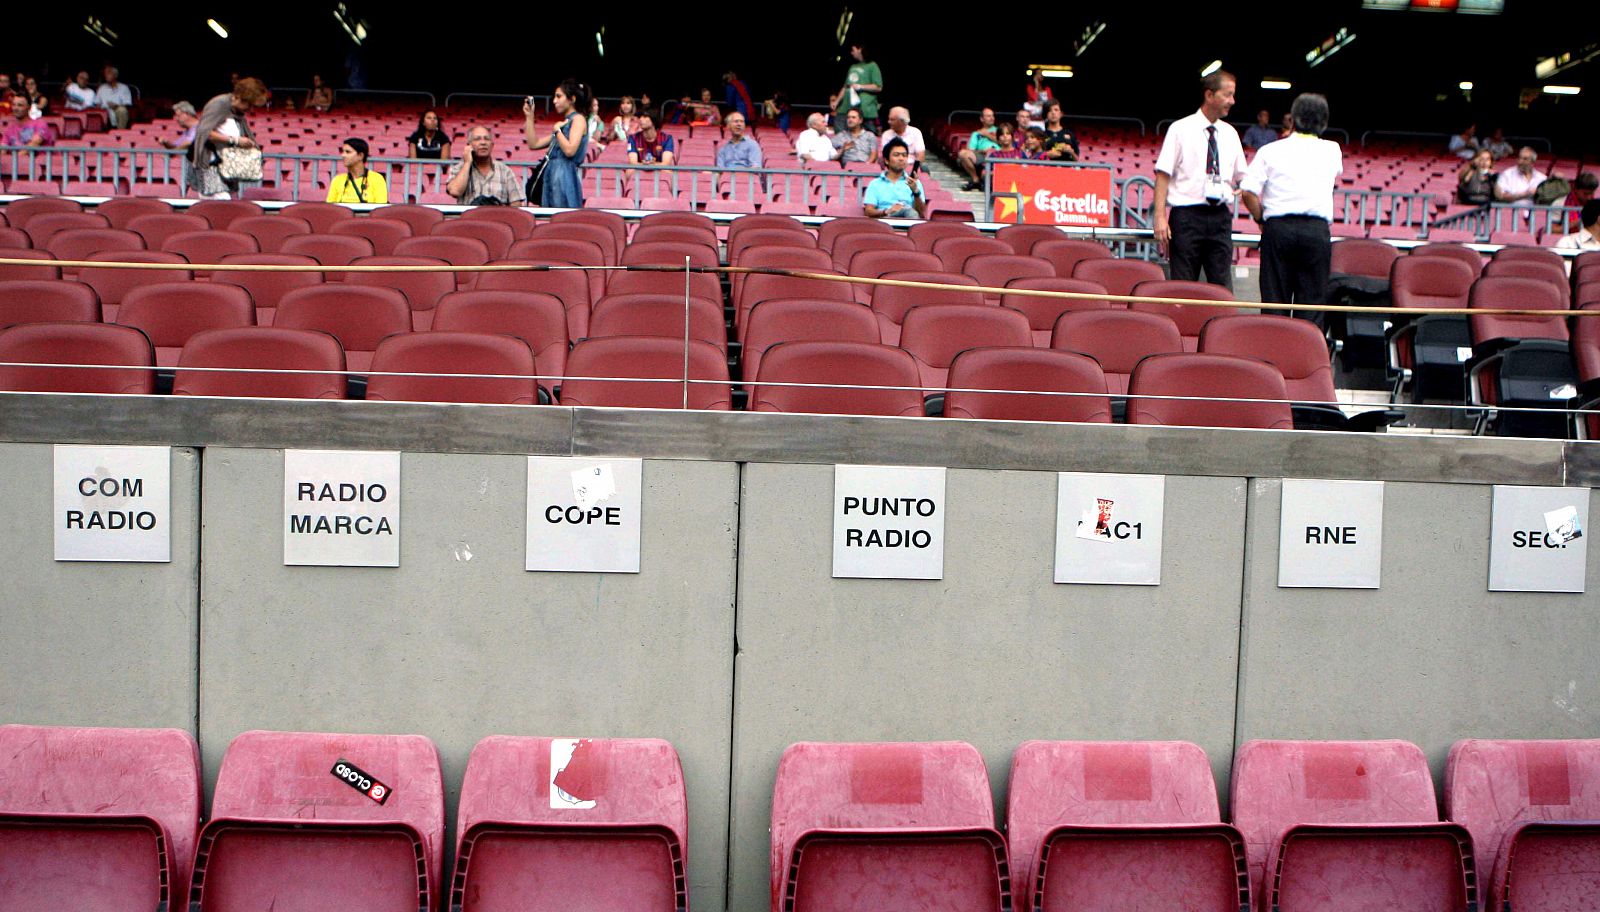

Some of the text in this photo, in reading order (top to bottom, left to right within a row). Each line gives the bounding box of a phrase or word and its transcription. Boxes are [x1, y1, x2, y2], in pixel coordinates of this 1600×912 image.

[1034, 188, 1109, 214] Estrella
[1055, 210, 1087, 224] Damm
[78, 477, 143, 498] COM
[298, 482, 387, 503] RADIO
[545, 505, 621, 526] COPE
[843, 496, 936, 517] PUNTO
[66, 510, 157, 532] RADIO
[290, 514, 393, 535] MARCA
[846, 528, 932, 549] RADIO
[1305, 526, 1357, 545] RNE
[335, 763, 371, 790] CLOSD
